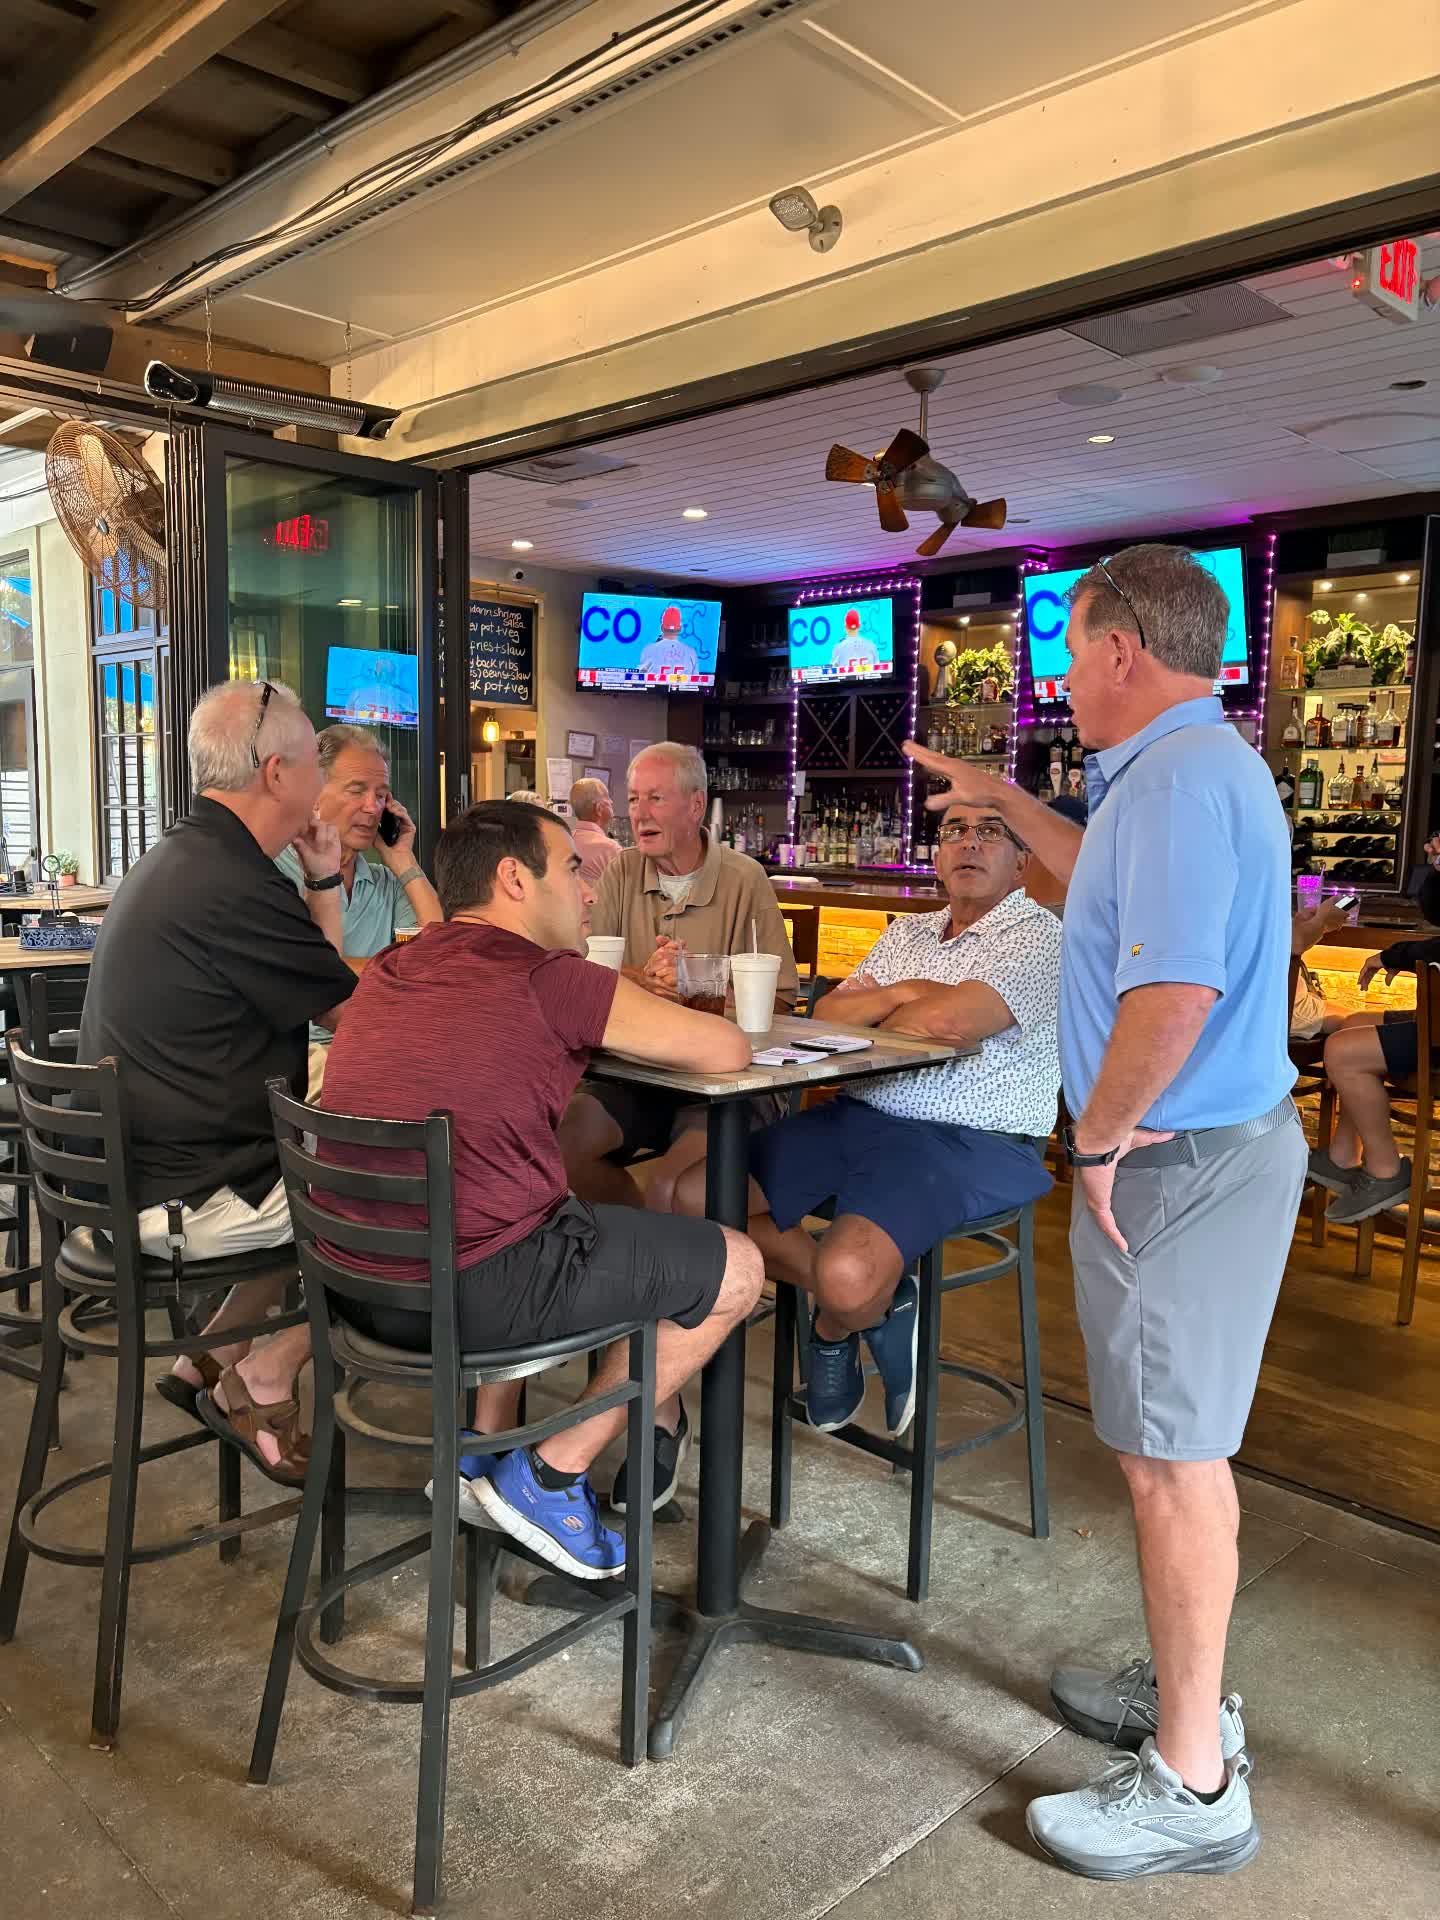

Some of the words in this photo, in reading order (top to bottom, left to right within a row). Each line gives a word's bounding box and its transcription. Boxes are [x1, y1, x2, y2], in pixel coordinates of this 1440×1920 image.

[1380, 240, 1417, 304] EXIT
[481, 622, 494, 637] pot
[583, 606, 641, 643] CO
[790, 616, 830, 647] CO
[1027, 590, 1064, 640] C
[484, 680, 504, 696] pot
